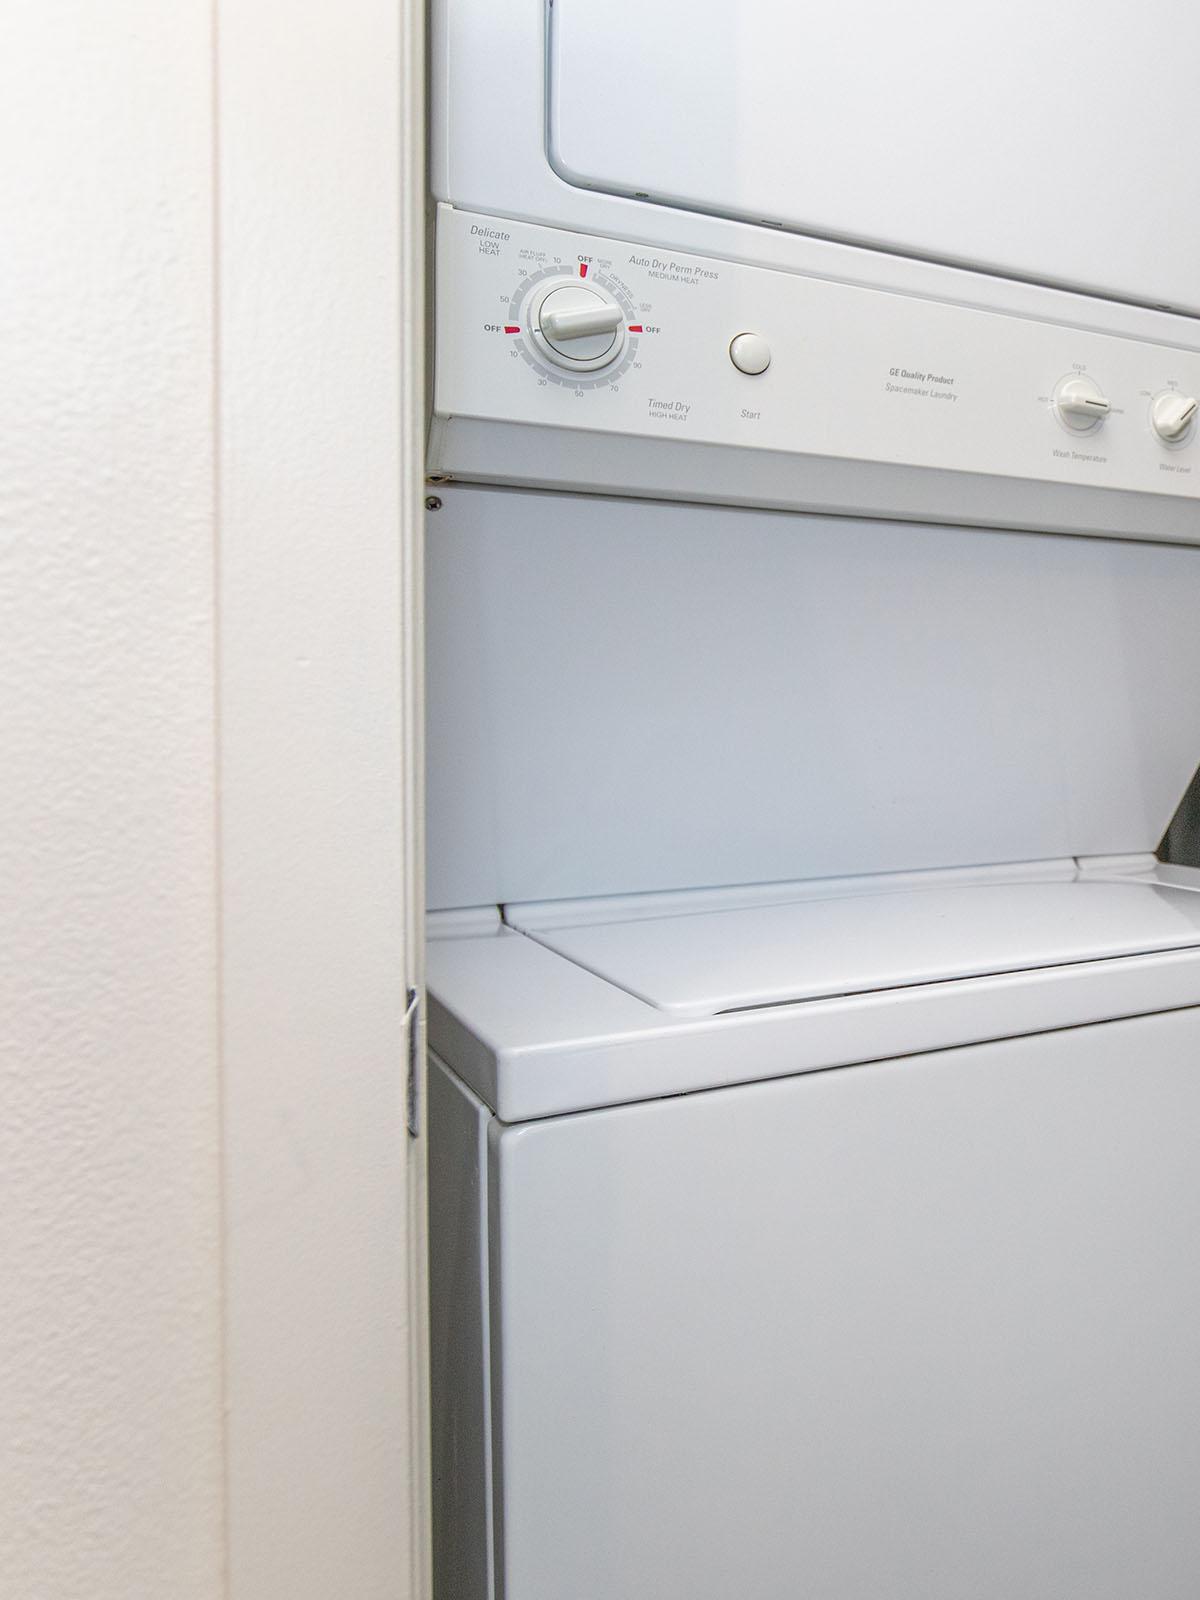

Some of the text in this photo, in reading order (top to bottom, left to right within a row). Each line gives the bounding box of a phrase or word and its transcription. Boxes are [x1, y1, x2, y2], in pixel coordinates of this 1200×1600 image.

[470, 224, 511, 241] Delicate
[479, 240, 500, 249] LOW
[478, 247, 501, 256] HEAT
[553, 256, 562, 264] 10
[577, 254, 593, 263] OFF
[628, 255, 720, 280] Auto Dry Perm Press
[518, 269, 528, 277] 30
[647, 270, 699, 285] MEDIUM HEAT
[609, 272, 635, 299] DRYNESS
[499, 295, 510, 303] 50
[483, 324, 502, 333] OFF
[645, 325, 661, 334] OFF
[509, 350, 518, 358] 10
[633, 361, 642, 369] 90
[889, 367, 954, 385] GE Quality Product
[537, 378, 547, 387] 30
[609, 384, 619, 393] 70
[885, 382, 958, 403] Spacemaker Laundry
[574, 390, 584, 398] 50
[647, 398, 691, 414] Timed Dry
[648, 411, 687, 422] HIGH HEAT
[740, 408, 761, 420] Start
[1052, 449, 1108, 464] Wash Temperature
[1159, 463, 1192, 473] Water Level
